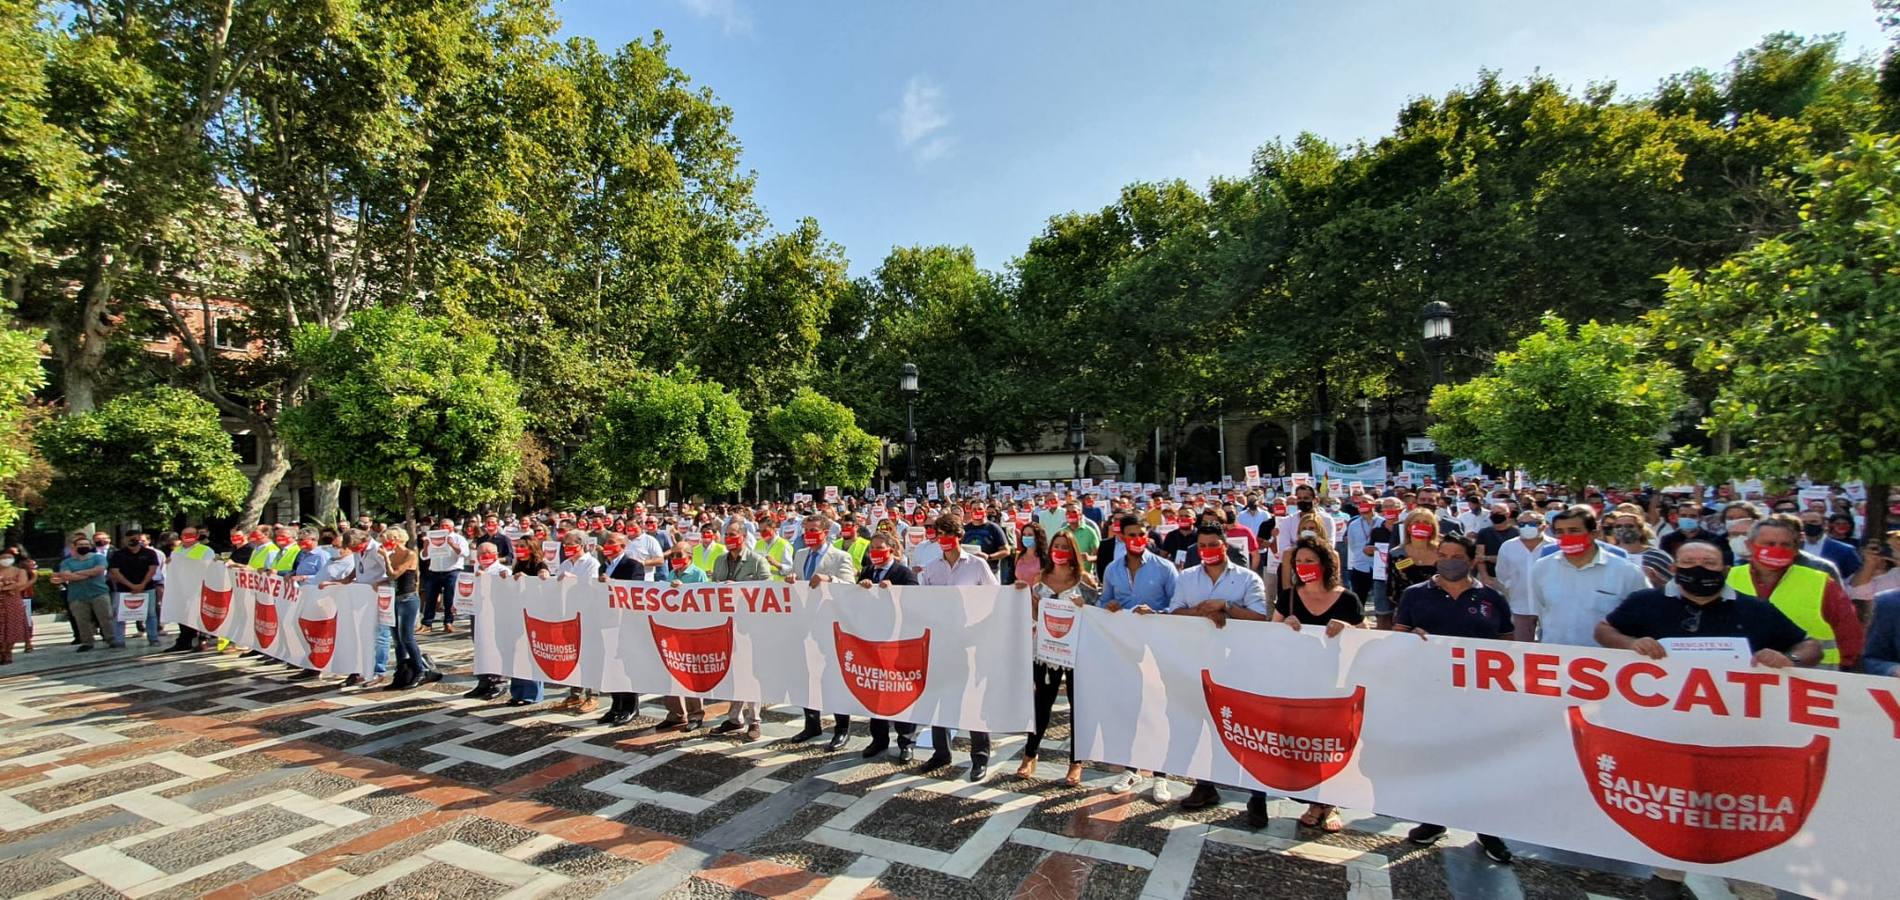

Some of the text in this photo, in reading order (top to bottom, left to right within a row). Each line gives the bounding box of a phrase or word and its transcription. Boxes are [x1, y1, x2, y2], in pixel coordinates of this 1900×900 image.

[608, 585, 792, 613] ¡RESCATE YA!
[531, 640, 577, 654] SALVEMOSEL
[661, 649, 727, 663] SALVEMOSLA
[844, 661, 922, 681] SALVEMOSLOS
[856, 676, 913, 692] CATERING
[1452, 647, 1840, 729] ¡RESCATE
[1222, 719, 1345, 752] SALVEMOSEL
[1224, 731, 1344, 763] OCIONOCTURNO
[1598, 771, 1795, 816] SALVEMOSLA
[1605, 789, 1786, 832] HOSTELERIA
